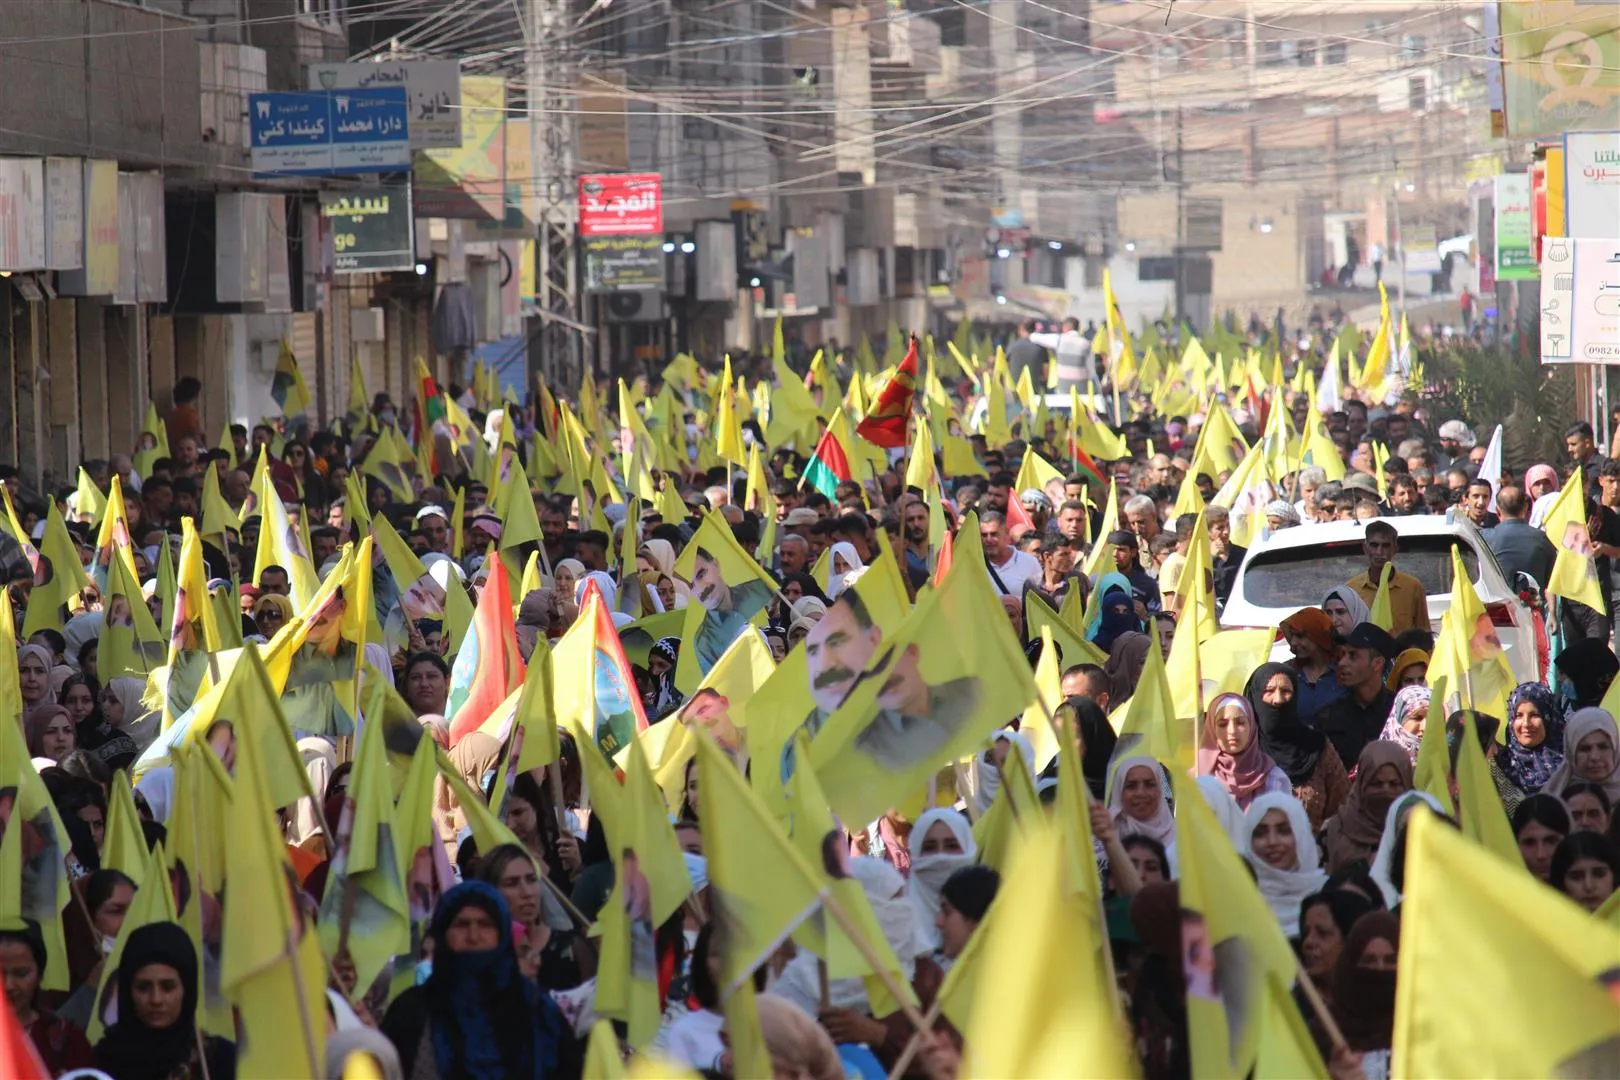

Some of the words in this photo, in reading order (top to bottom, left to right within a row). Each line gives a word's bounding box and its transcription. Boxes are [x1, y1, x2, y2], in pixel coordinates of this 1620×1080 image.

[288, 118, 325, 140] كيندا
[337, 116, 373, 133] محمد
[378, 115, 402, 135] دارا
[1588, 346, 1612, 355] 0982
